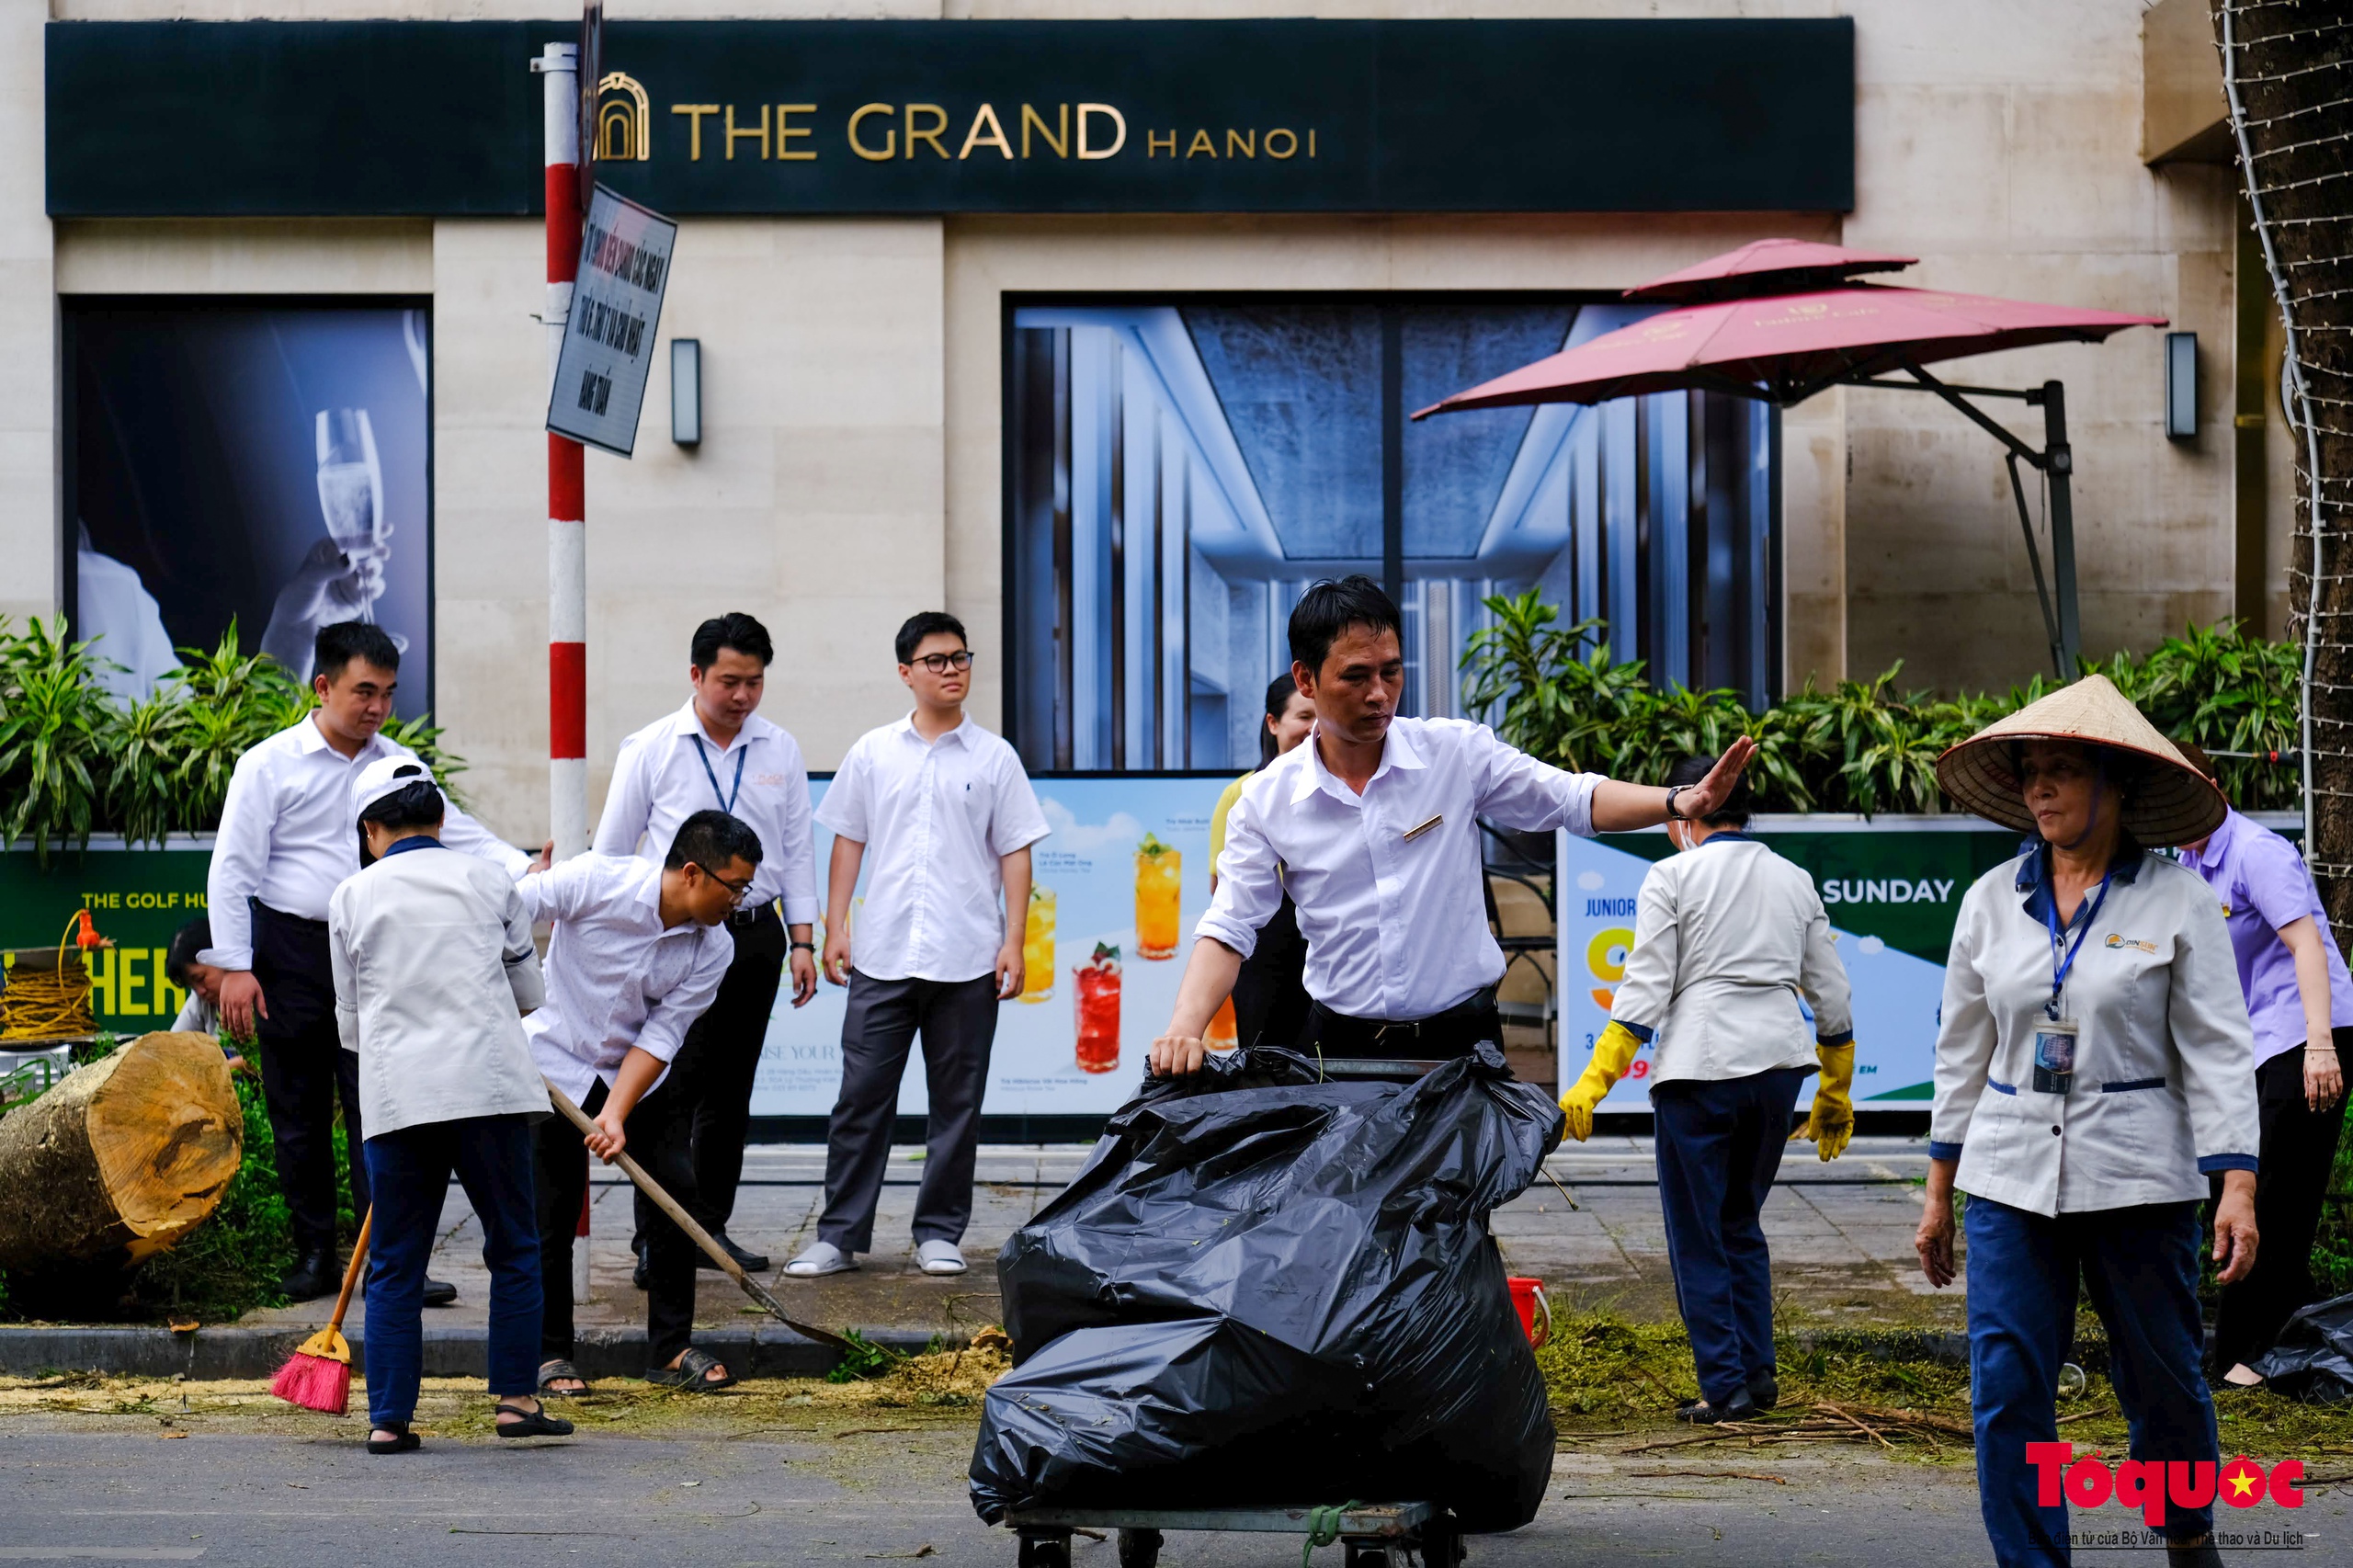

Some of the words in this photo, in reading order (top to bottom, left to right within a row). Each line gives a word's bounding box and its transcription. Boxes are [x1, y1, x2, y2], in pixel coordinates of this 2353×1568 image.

[671, 103, 817, 161] THE
[847, 102, 1127, 161] GRAND
[1148, 128, 1316, 159] HANOI
[631, 239, 647, 288] CÁC
[642, 246, 665, 295] NGÀY
[81, 892, 120, 908] THE
[126, 892, 179, 908] GOLF
[1822, 879, 1955, 904] SUNDAY
